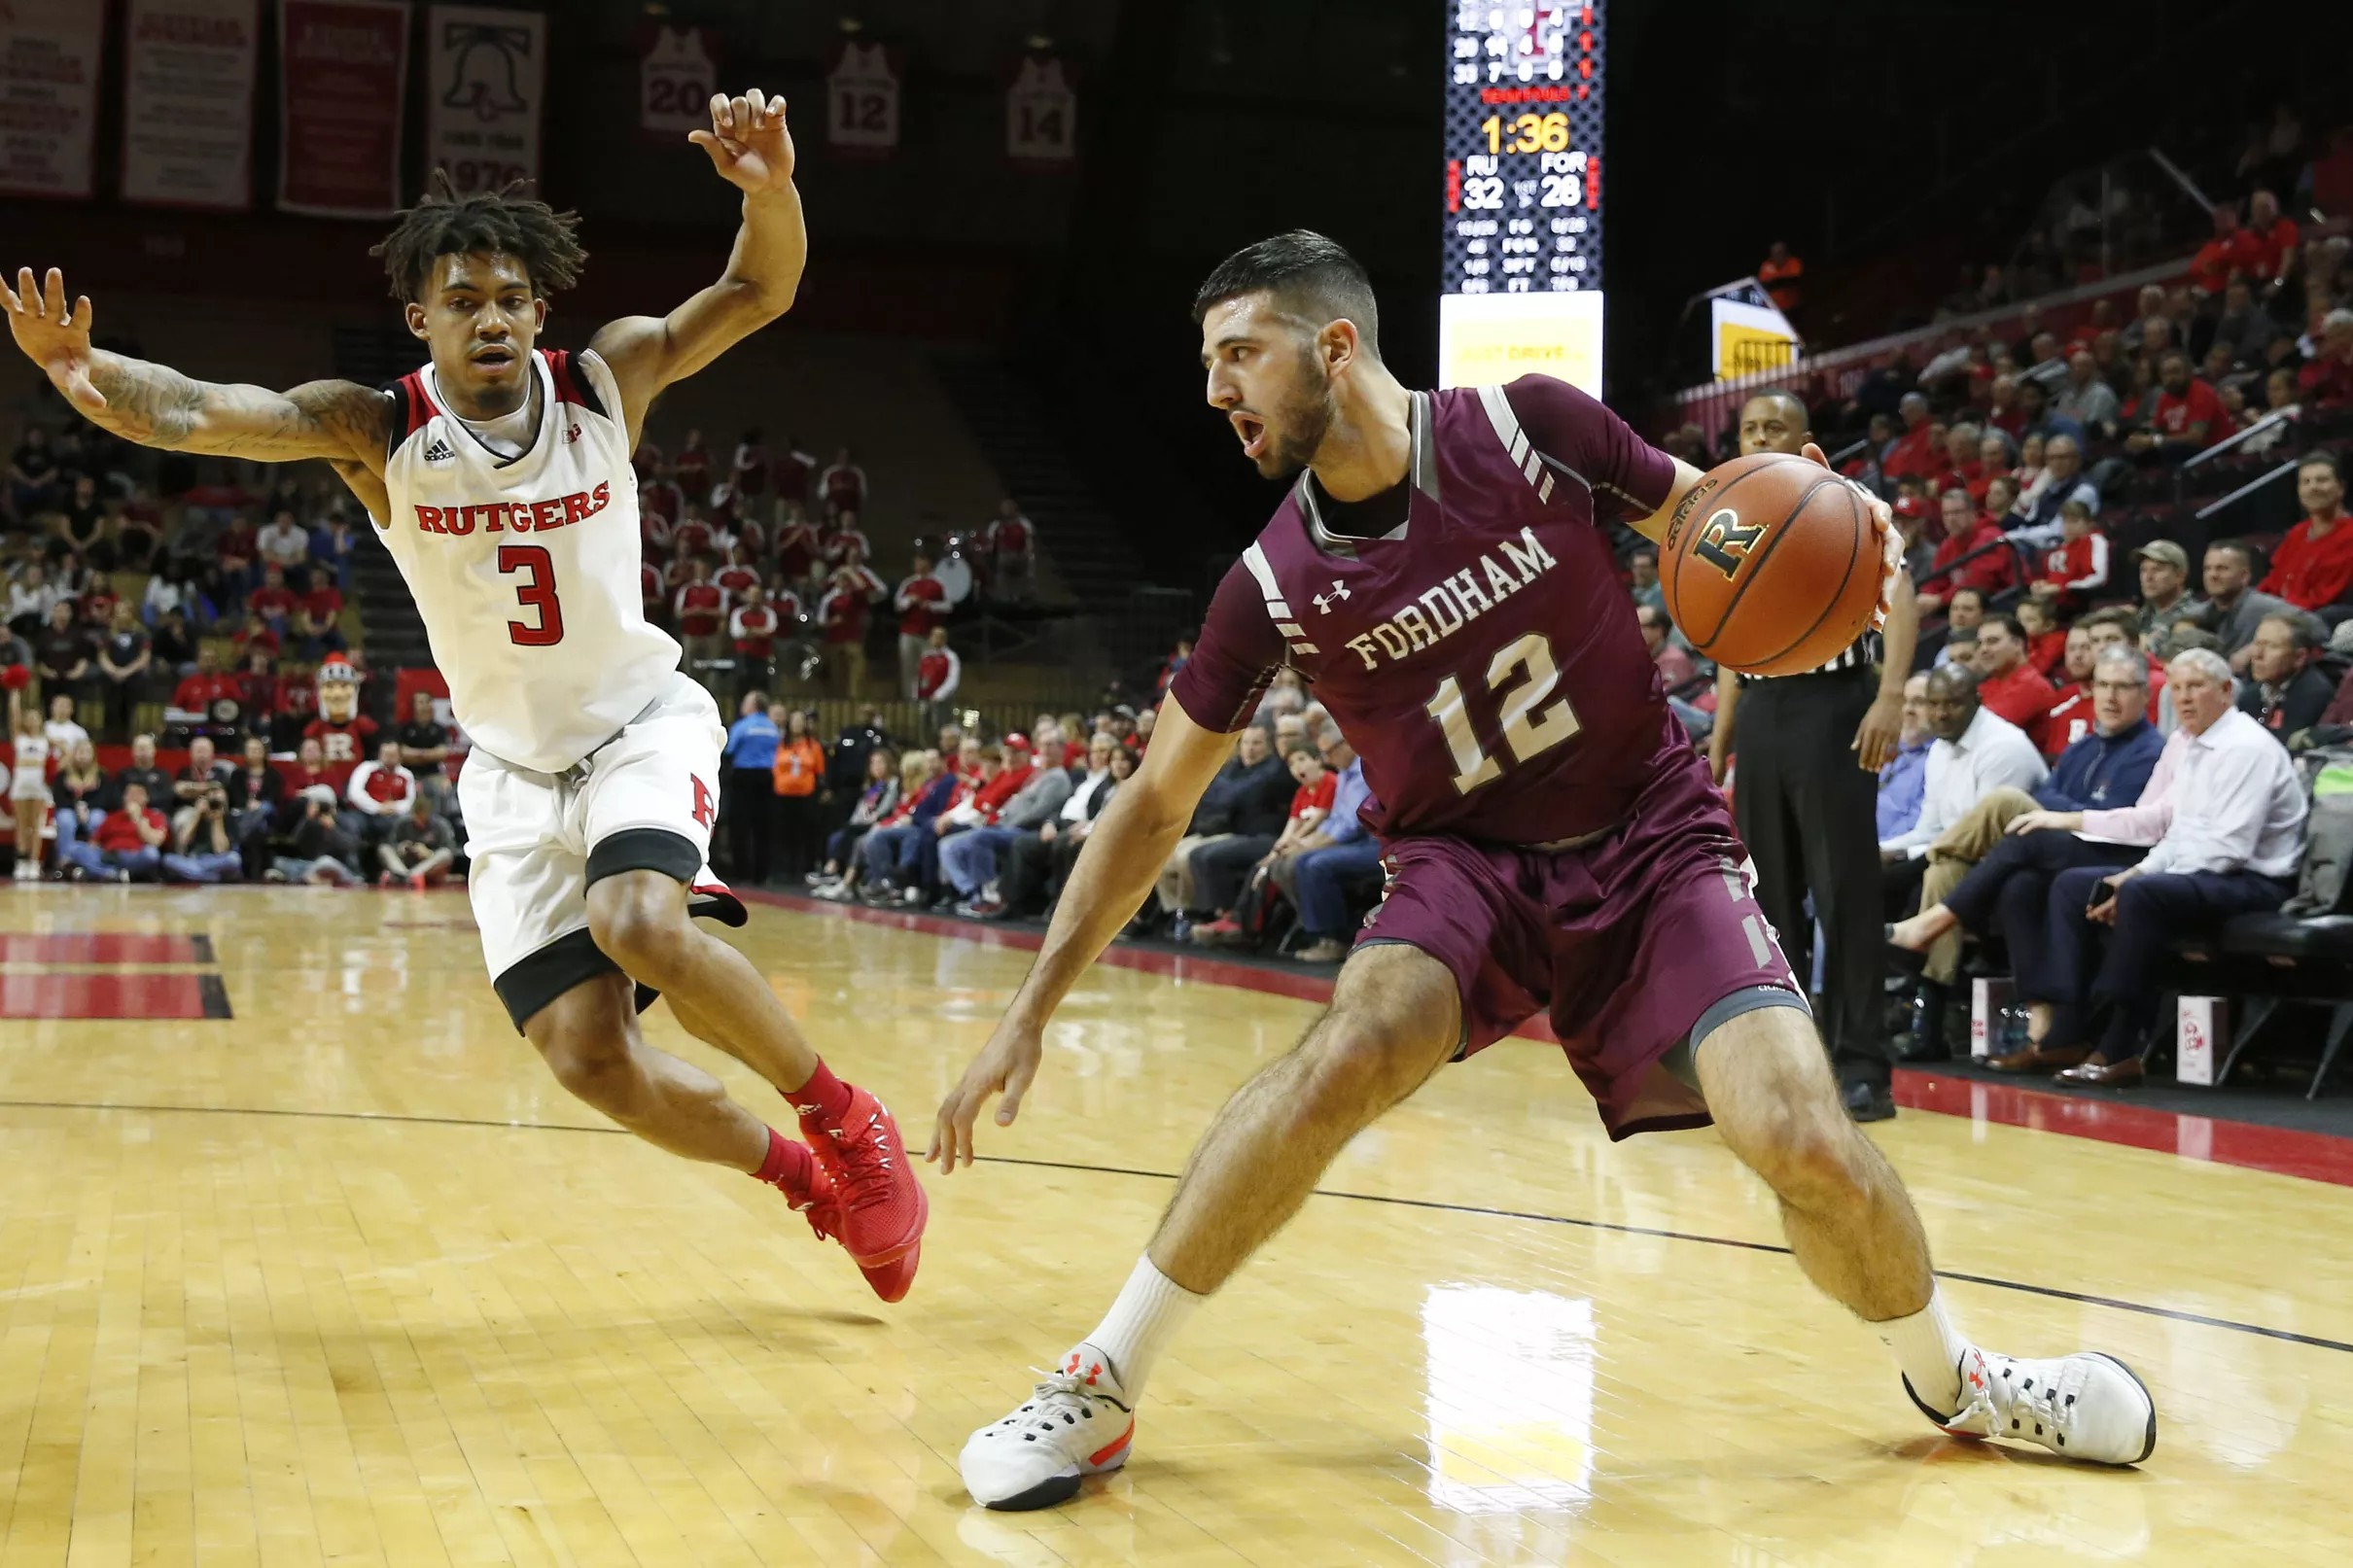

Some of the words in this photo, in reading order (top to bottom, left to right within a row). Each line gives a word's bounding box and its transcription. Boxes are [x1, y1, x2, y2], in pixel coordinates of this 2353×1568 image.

[649, 77, 707, 118] 20
[839, 92, 888, 132] 12
[1020, 107, 1064, 146] 14
[1481, 112, 1570, 155] 1:36
[1466, 155, 1498, 177] RU
[1541, 151, 1588, 174] FOR
[1463, 177, 1505, 210] 32
[1540, 174, 1582, 207] 28
[414, 479, 611, 536] RUTGERS
[1667, 478, 1718, 552] adidas
[1691, 507, 1770, 583] R
[498, 545, 564, 646] 3
[1344, 526, 1557, 671] FORDHAM
[1423, 632, 1583, 795] 12
[323, 733, 355, 760] R
